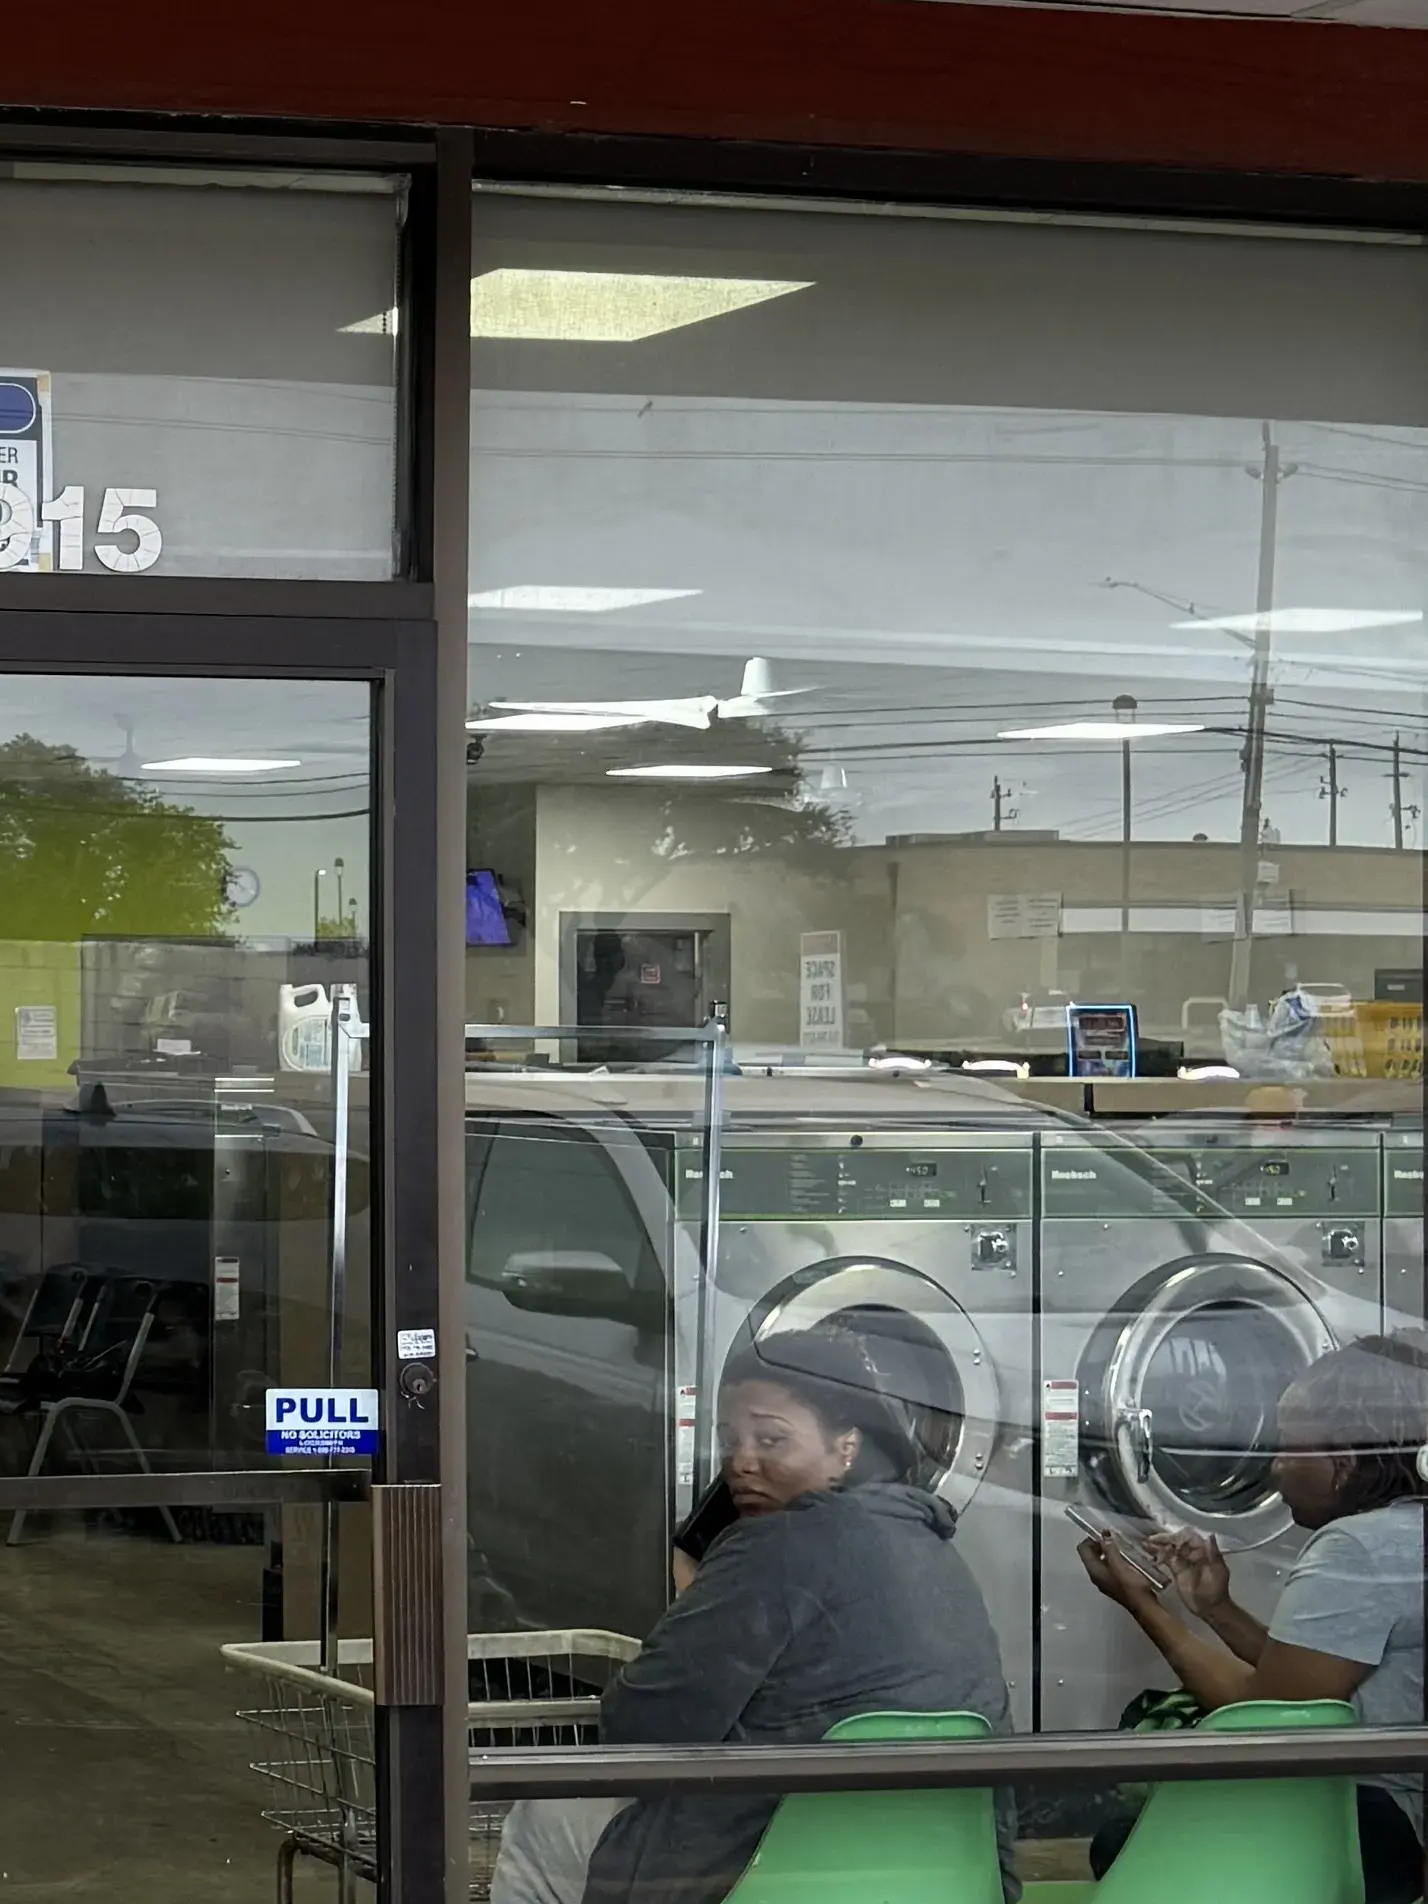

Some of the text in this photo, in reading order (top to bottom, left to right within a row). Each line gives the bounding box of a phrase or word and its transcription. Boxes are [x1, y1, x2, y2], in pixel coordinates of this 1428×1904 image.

[276, 1398, 369, 1423] PULL
[281, 1430, 361, 1440] NO SOLICITORS
